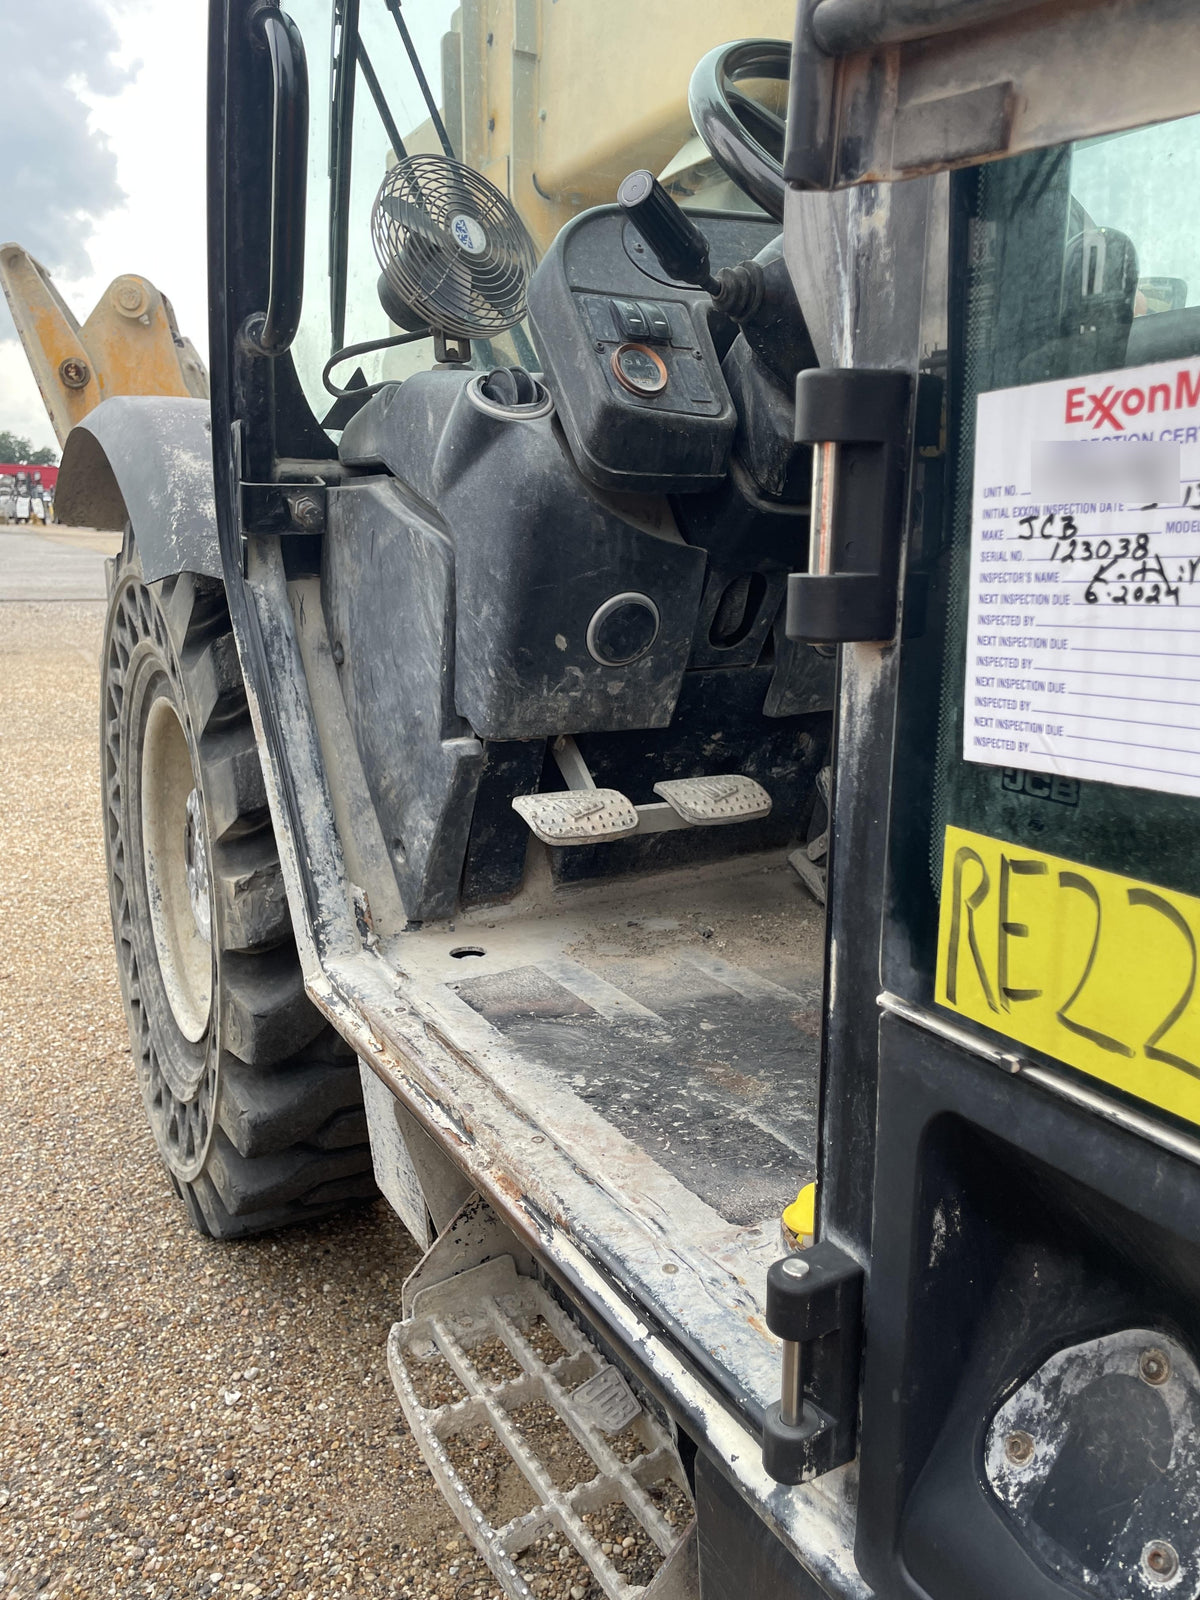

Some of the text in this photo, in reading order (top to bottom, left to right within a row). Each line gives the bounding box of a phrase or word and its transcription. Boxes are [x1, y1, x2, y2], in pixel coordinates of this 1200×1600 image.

[1159, 426, 1200, 444] CER
[983, 485, 1018, 498] UNIT NO.
[983, 502, 1124, 520] INITIAL EXXON INSPECTION DATE
[1018, 514, 1077, 540] JCB
[982, 529, 1004, 541] MAKE
[1050, 533, 1149, 563] 123038
[980, 550, 1008, 562] SERIAL
[979, 571, 1060, 584] INSPECTOR'S NAME
[979, 593, 1071, 605] NEXT INSPECTION DUE
[977, 614, 1035, 626] INSPECTED BY
[977, 635, 1069, 650] NEXT INSPECTION DUE
[976, 656, 1033, 669] INSPECTED BY
[976, 676, 1066, 694] NEXT INSPECTION DUE
[975, 696, 1031, 711] INSPECTED BY
[974, 716, 1064, 736] NEXT INSPECTION DUE
[974, 736, 1030, 752] INSPECTED BY
[1002, 769, 1079, 805] JCB
